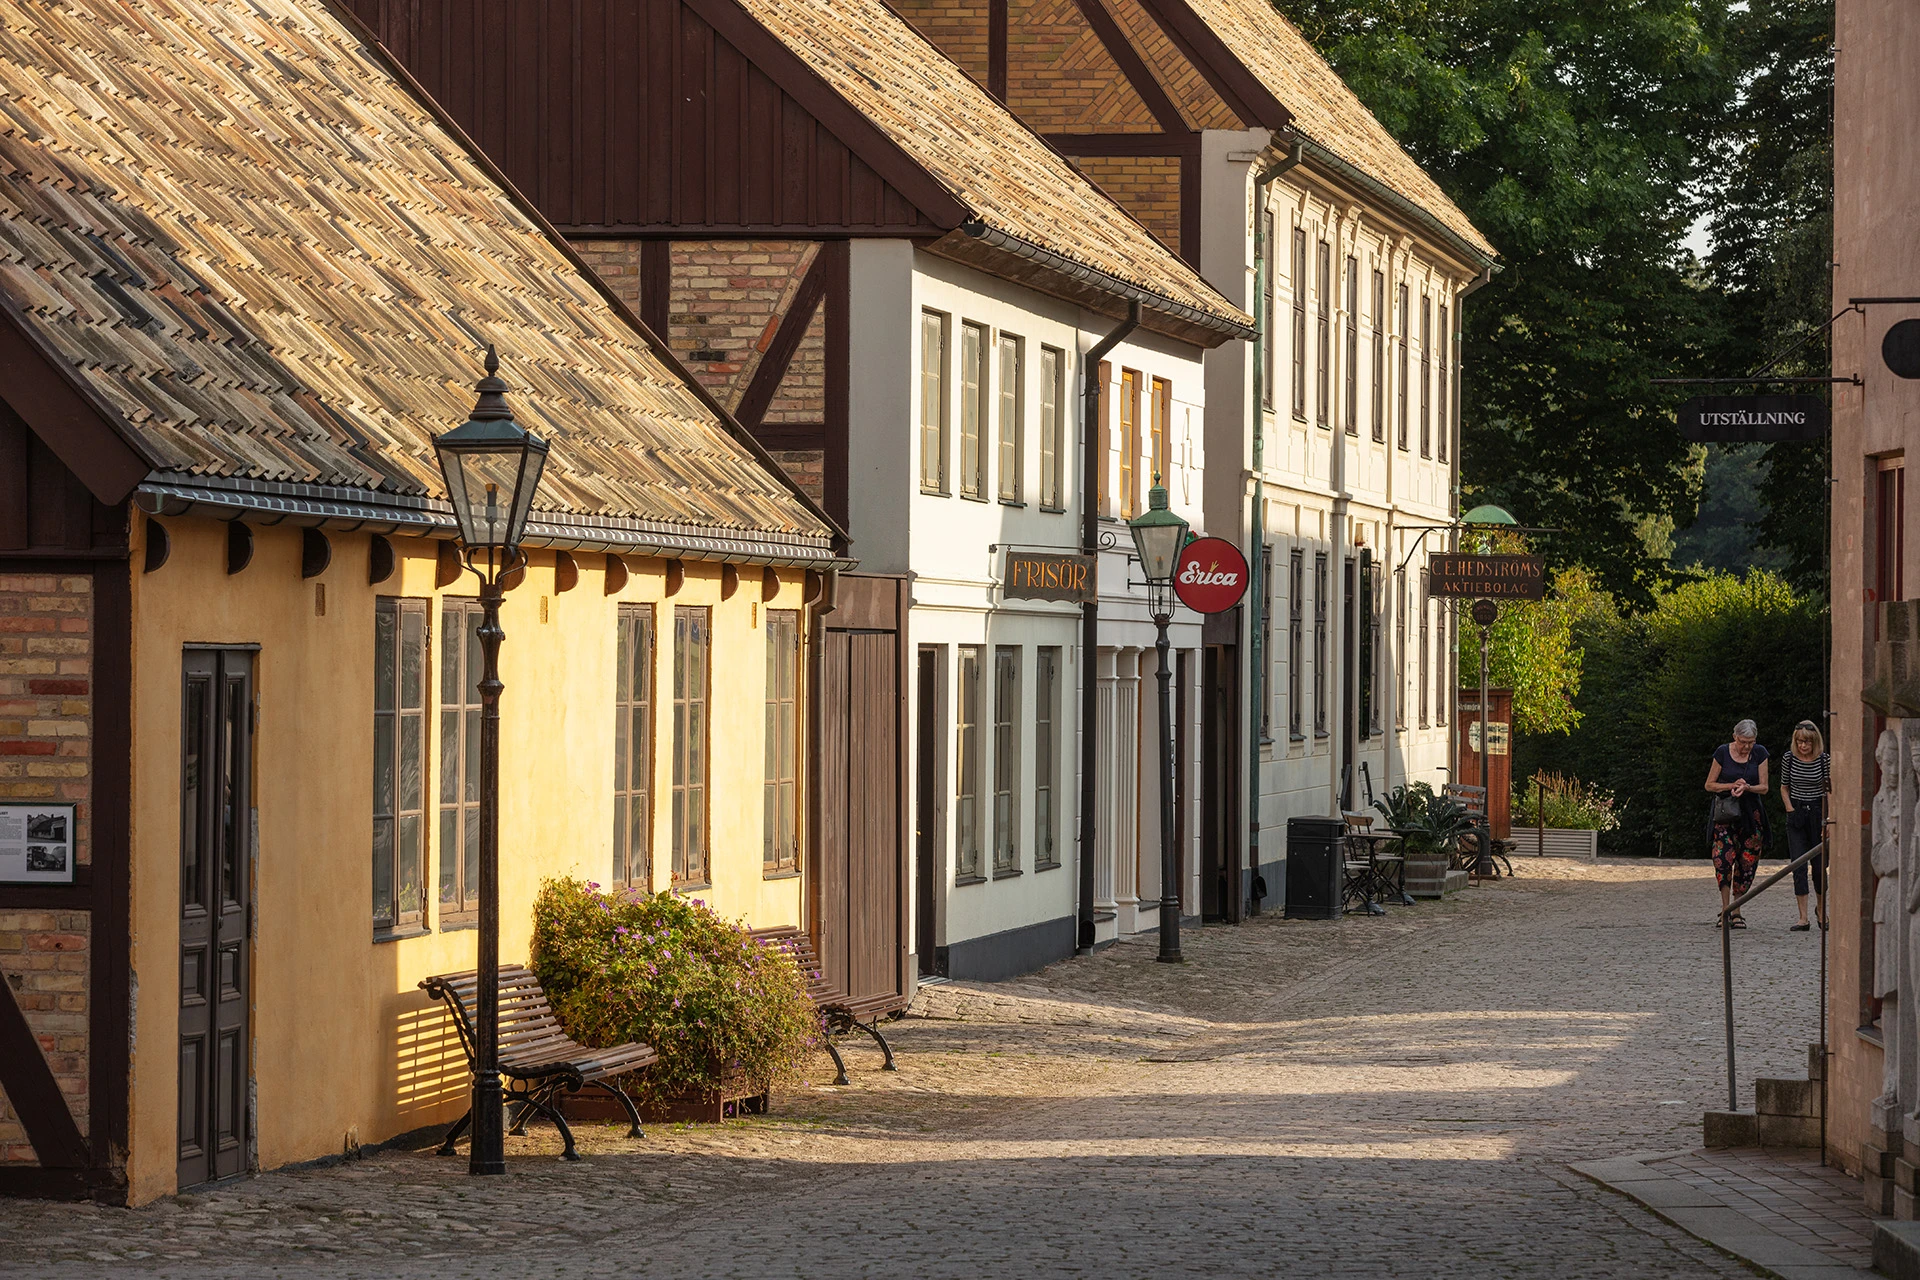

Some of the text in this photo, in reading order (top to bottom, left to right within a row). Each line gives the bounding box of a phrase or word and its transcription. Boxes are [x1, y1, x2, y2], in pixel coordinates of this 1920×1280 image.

[1700, 409, 1806, 426] UTSTÄLLNING
[1013, 559, 1087, 591] FRISÖR
[1179, 560, 1239, 587] Erica
[1457, 560, 1541, 578] HEDSTRÖMS
[1443, 581, 1529, 594] AKTIEBOLAG
